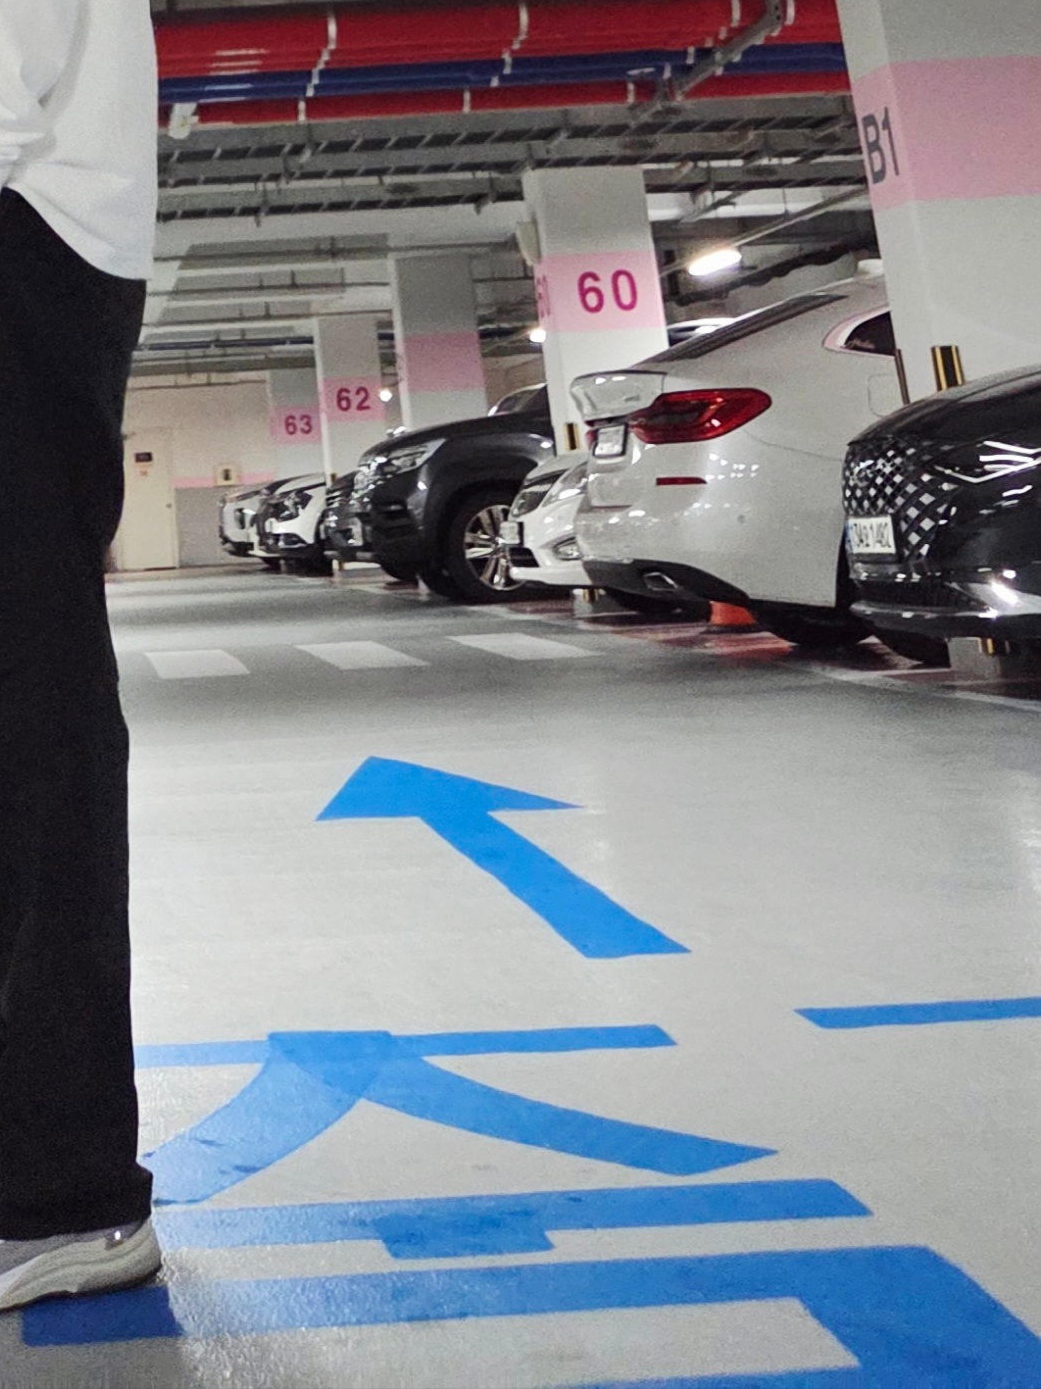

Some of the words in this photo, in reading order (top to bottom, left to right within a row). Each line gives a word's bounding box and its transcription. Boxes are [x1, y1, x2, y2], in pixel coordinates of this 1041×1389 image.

[862, 106, 900, 184] B1
[577, 269, 638, 314] 60
[336, 386, 371, 411] 62
[284, 414, 313, 435] 63
